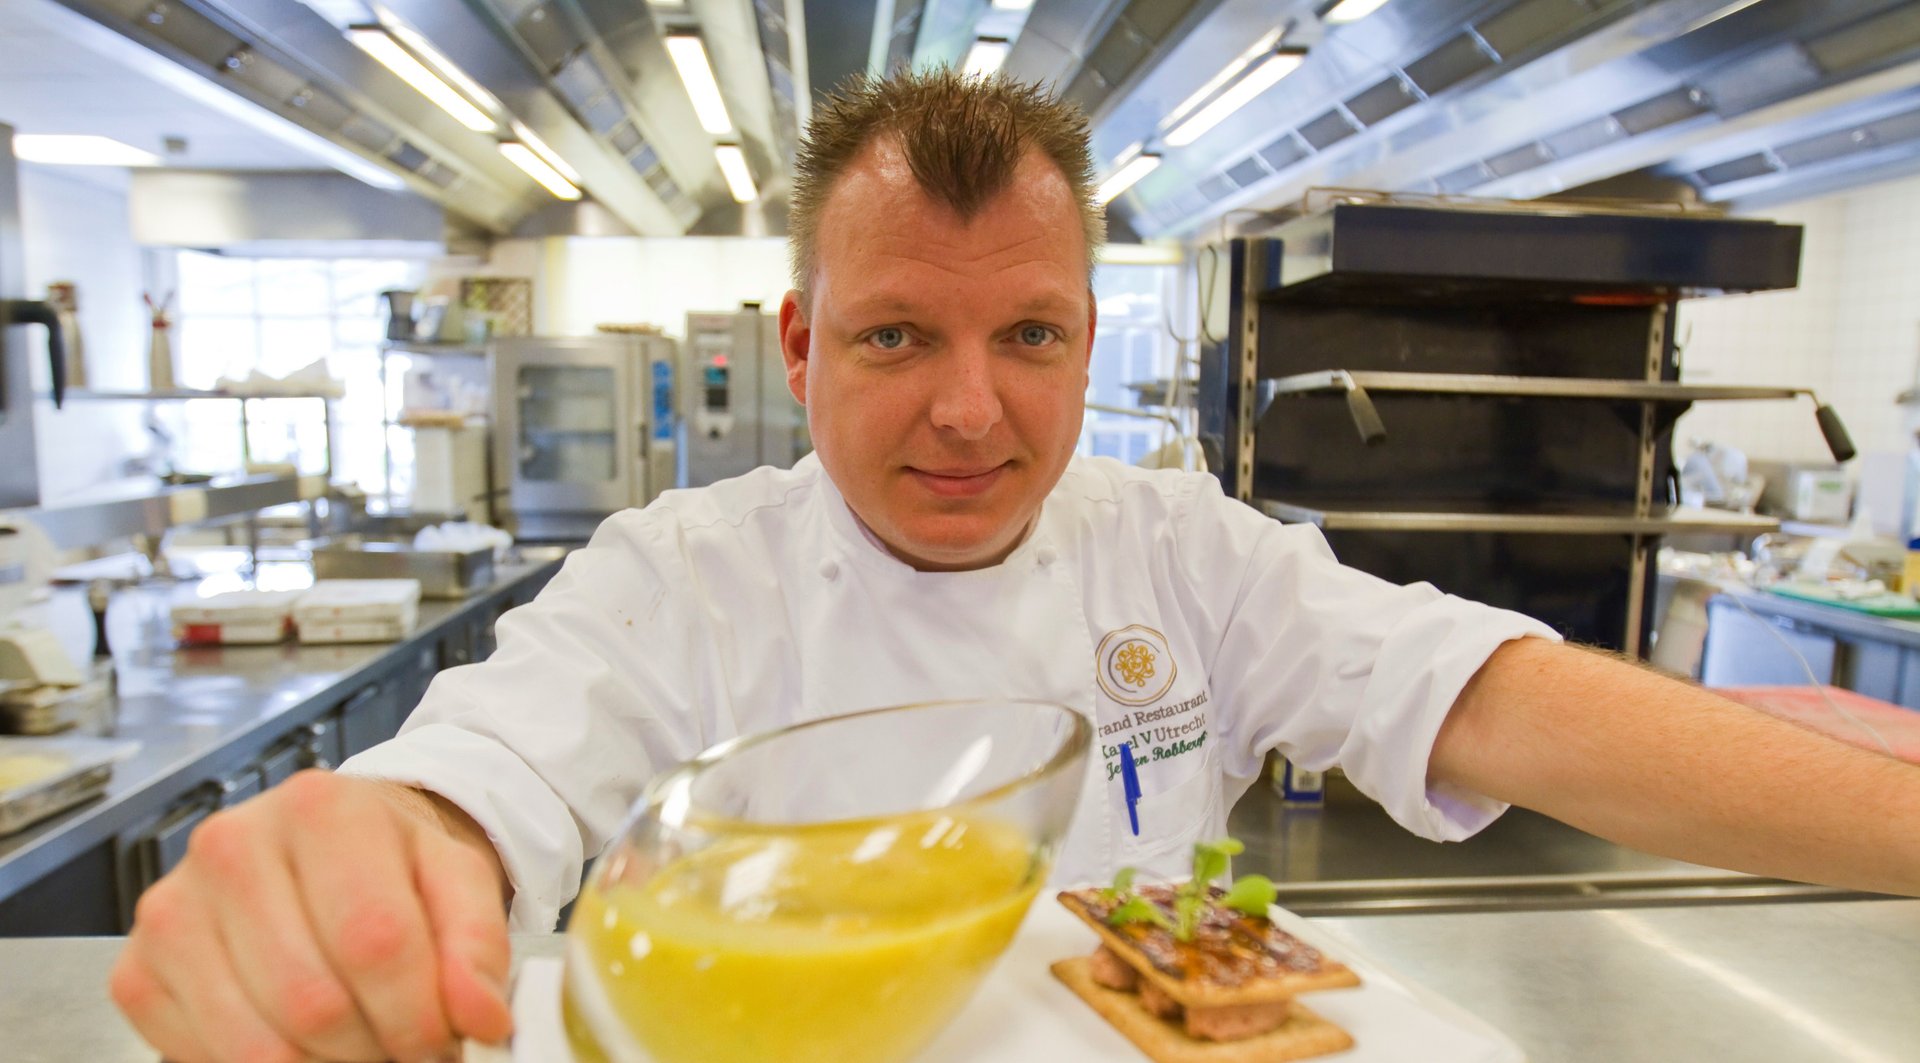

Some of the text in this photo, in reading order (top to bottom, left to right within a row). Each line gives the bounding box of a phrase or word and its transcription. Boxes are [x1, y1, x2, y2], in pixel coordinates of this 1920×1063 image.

[1098, 690, 1208, 737] rand Restaurant
[1102, 735, 1139, 759] Kael
[1139, 730, 1151, 745] V
[1106, 755, 1149, 781] Jeen
